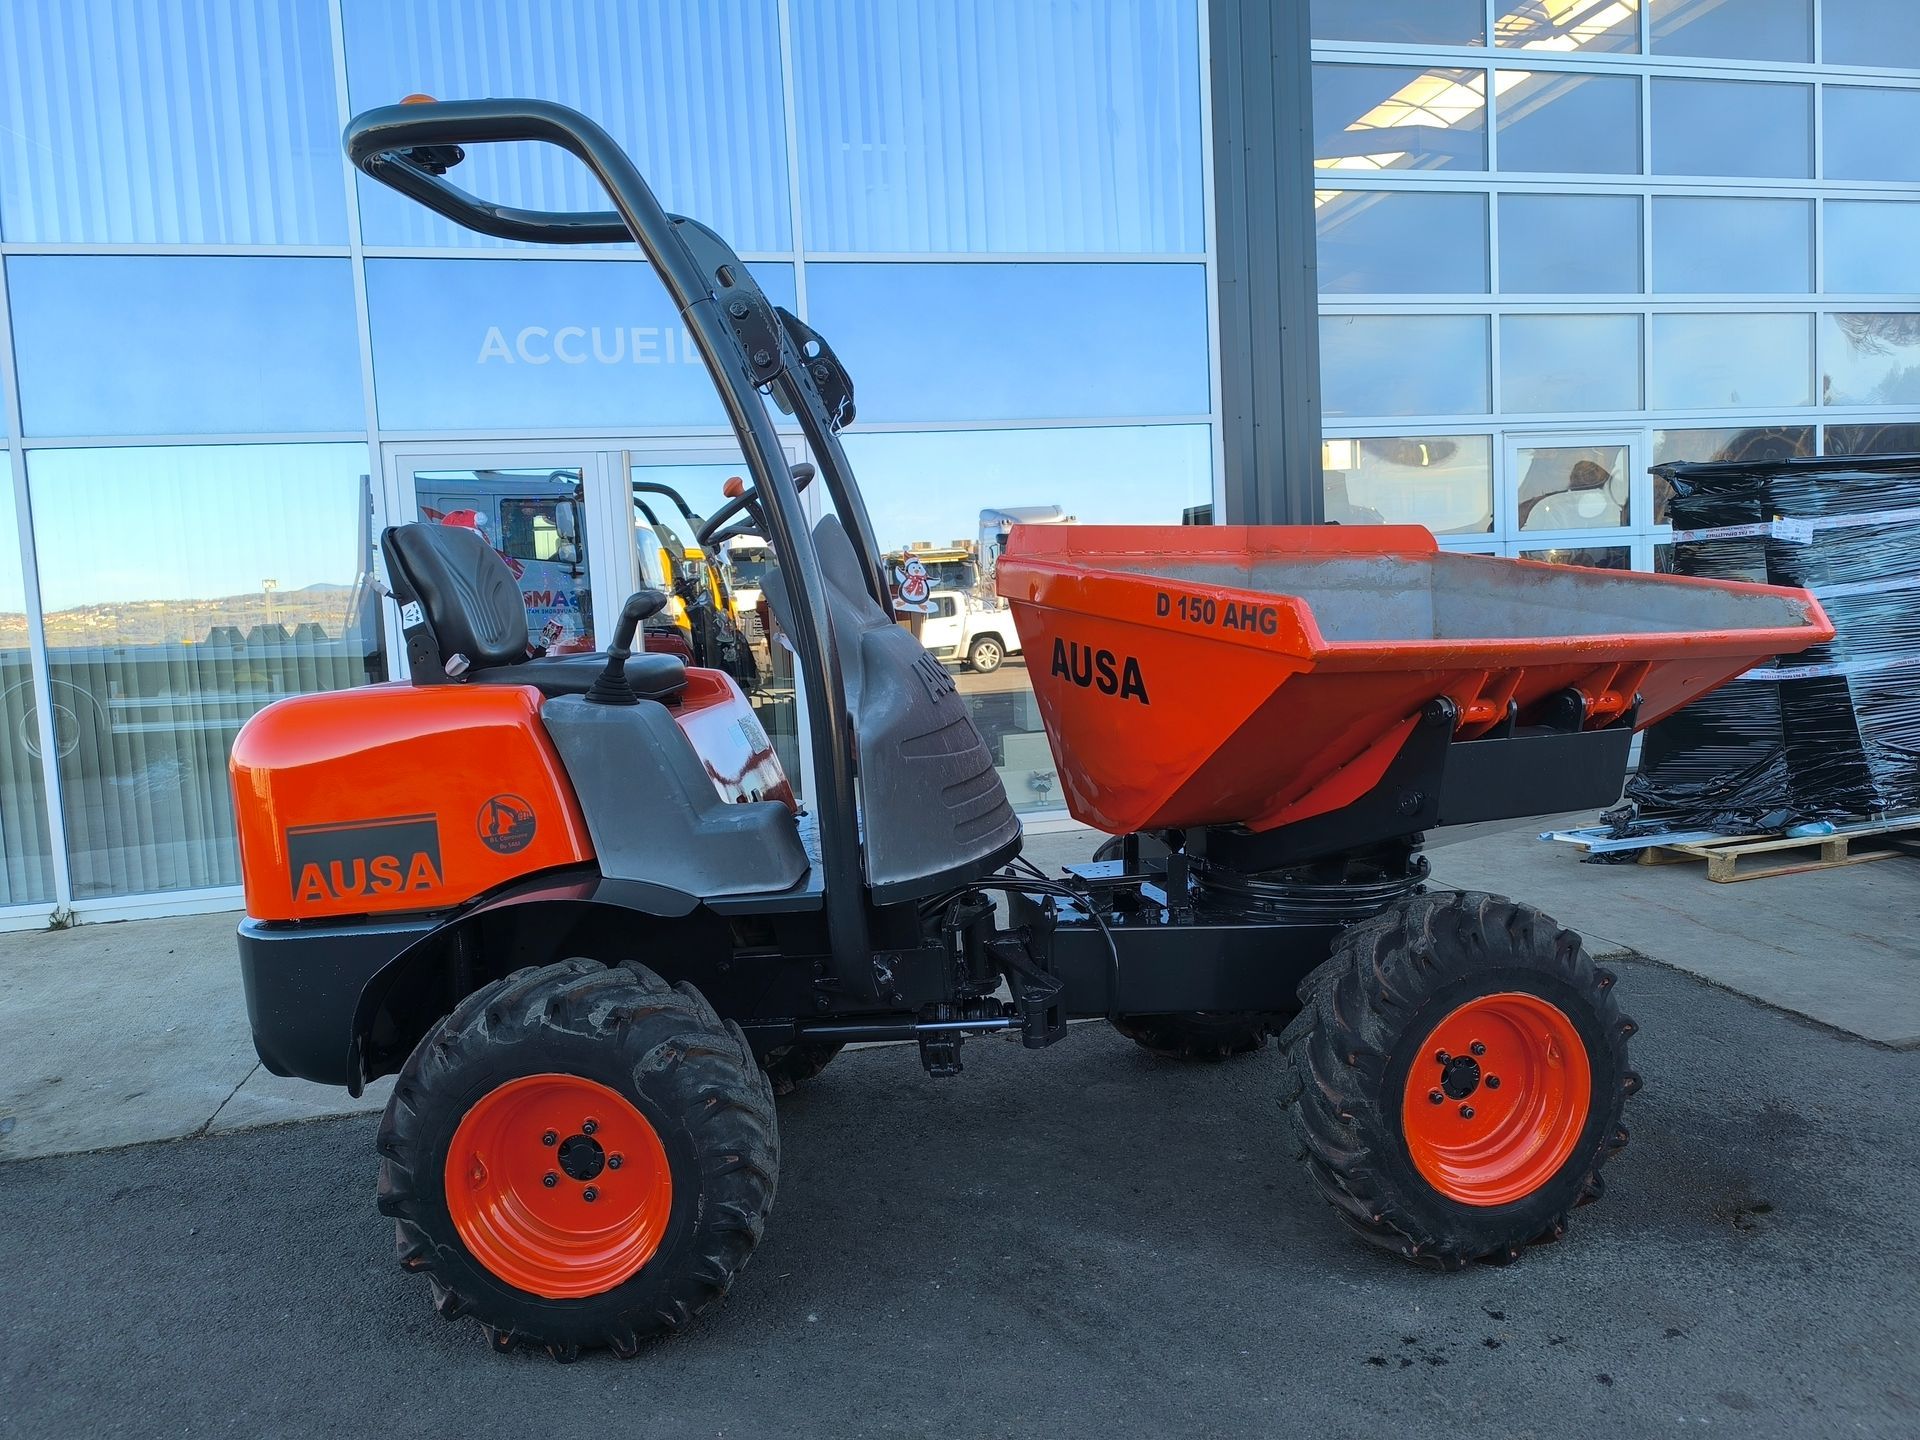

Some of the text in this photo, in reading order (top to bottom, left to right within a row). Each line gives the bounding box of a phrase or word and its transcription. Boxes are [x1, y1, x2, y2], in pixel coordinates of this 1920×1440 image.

[477, 326, 702, 365] ACCUEIL
[1156, 592, 1278, 635] D 150 AHG
[1051, 637, 1150, 705] AUSA
[295, 851, 445, 902] AUSA
